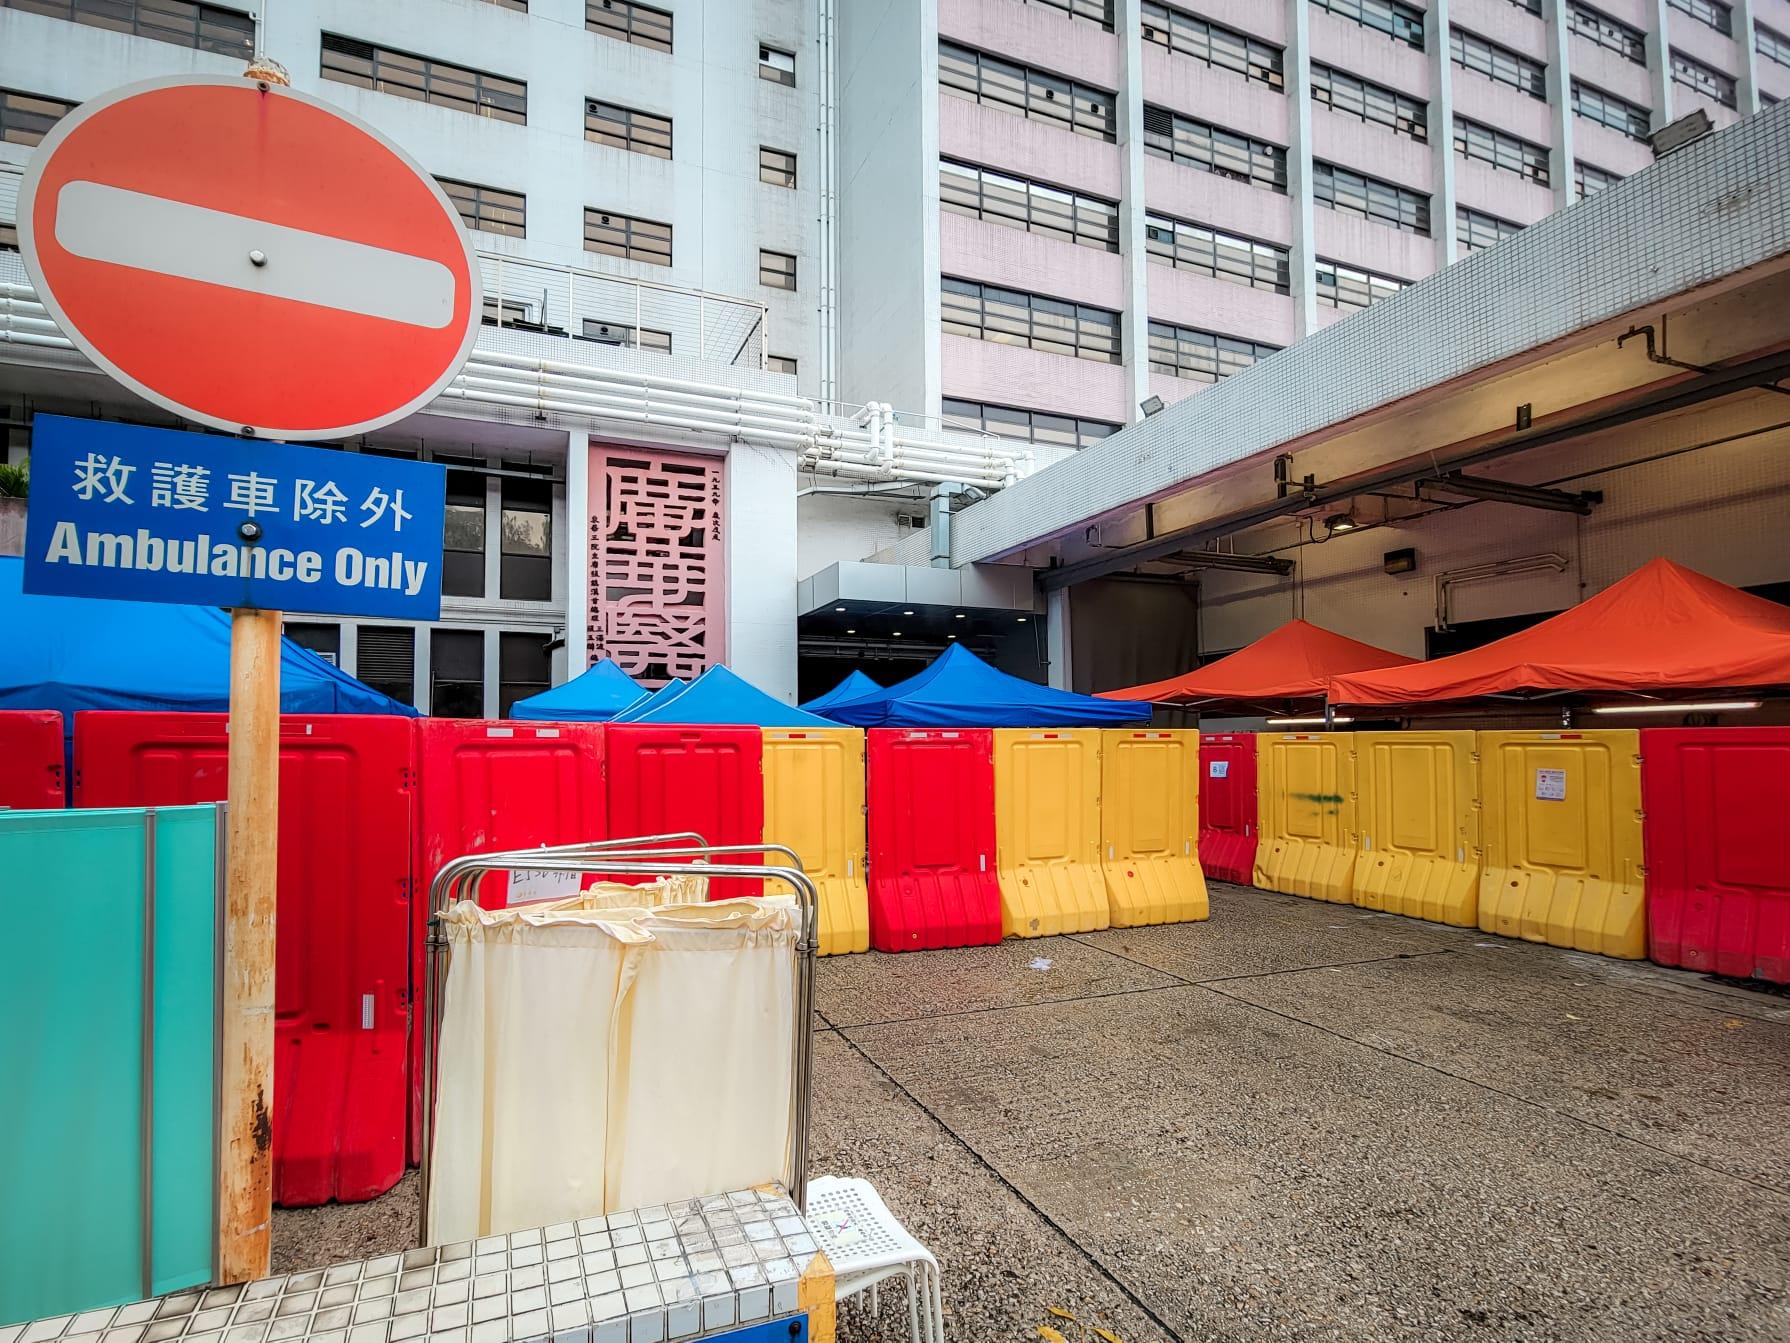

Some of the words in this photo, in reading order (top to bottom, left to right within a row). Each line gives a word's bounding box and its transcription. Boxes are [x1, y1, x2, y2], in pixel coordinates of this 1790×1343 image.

[72, 452, 414, 532] 救護車除外
[45, 521, 322, 584] Ambulance
[334, 547, 428, 596] Only
